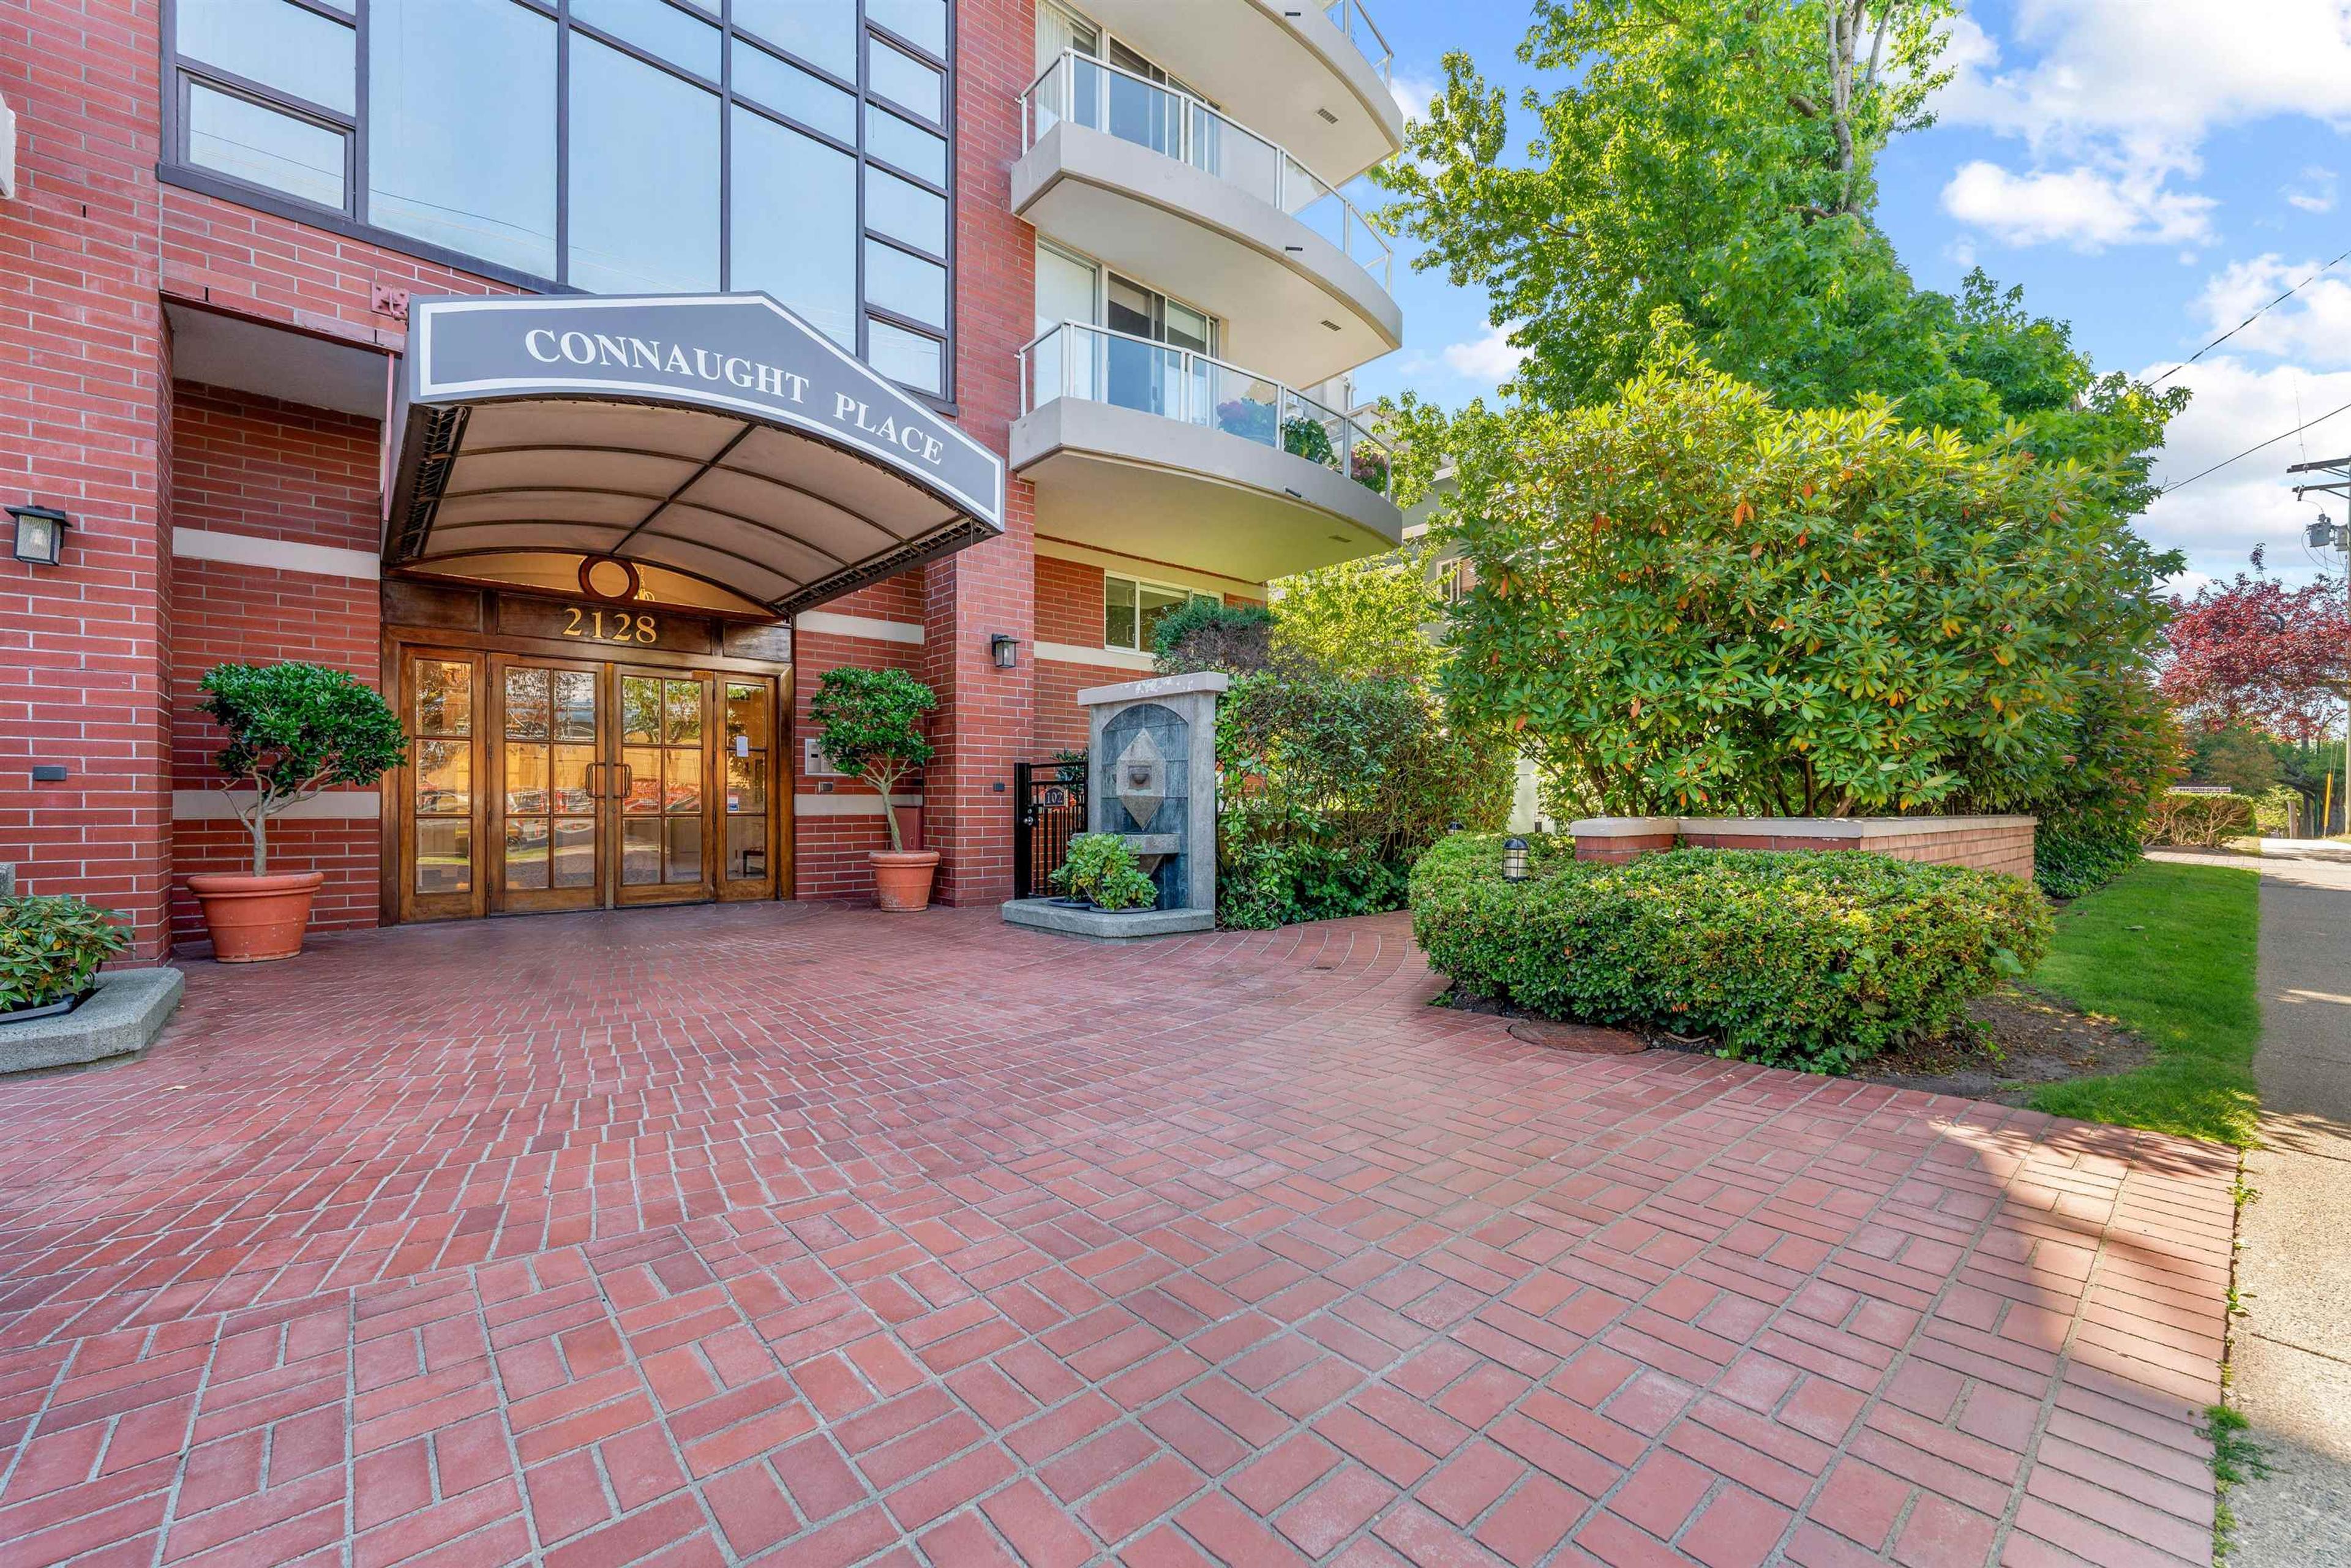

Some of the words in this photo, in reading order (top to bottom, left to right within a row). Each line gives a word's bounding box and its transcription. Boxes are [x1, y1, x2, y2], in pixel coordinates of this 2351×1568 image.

[525, 329, 809, 404] CONNAUGHT
[832, 391, 943, 465] PLACE
[562, 608, 657, 643] 2128
[1046, 792, 1063, 803] 102
